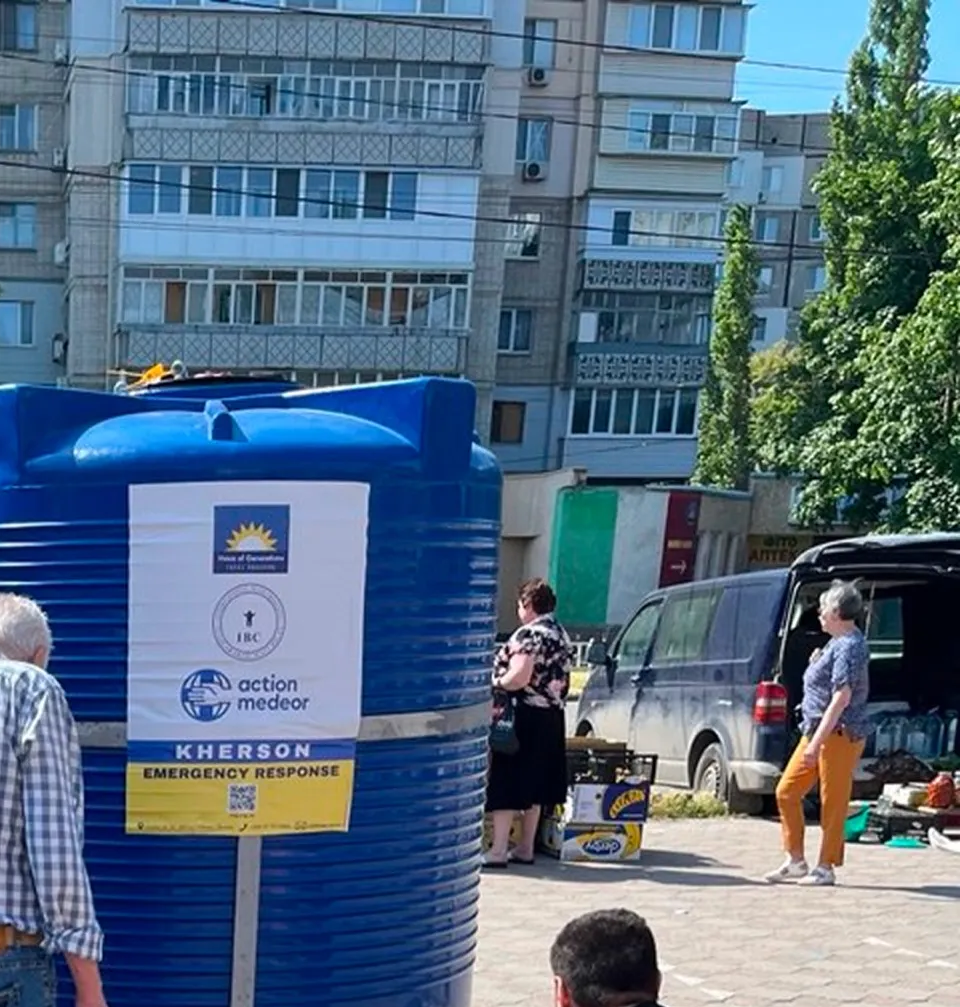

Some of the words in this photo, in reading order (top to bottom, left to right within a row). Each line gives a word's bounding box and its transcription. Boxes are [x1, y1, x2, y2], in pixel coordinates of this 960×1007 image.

[237, 631, 259, 643] IBC
[237, 673, 298, 693] action
[237, 693, 310, 712] medeor
[175, 743, 311, 760] KHERSON
[143, 768, 249, 780] EMERGENCY
[254, 765, 340, 779] RESPONSE
